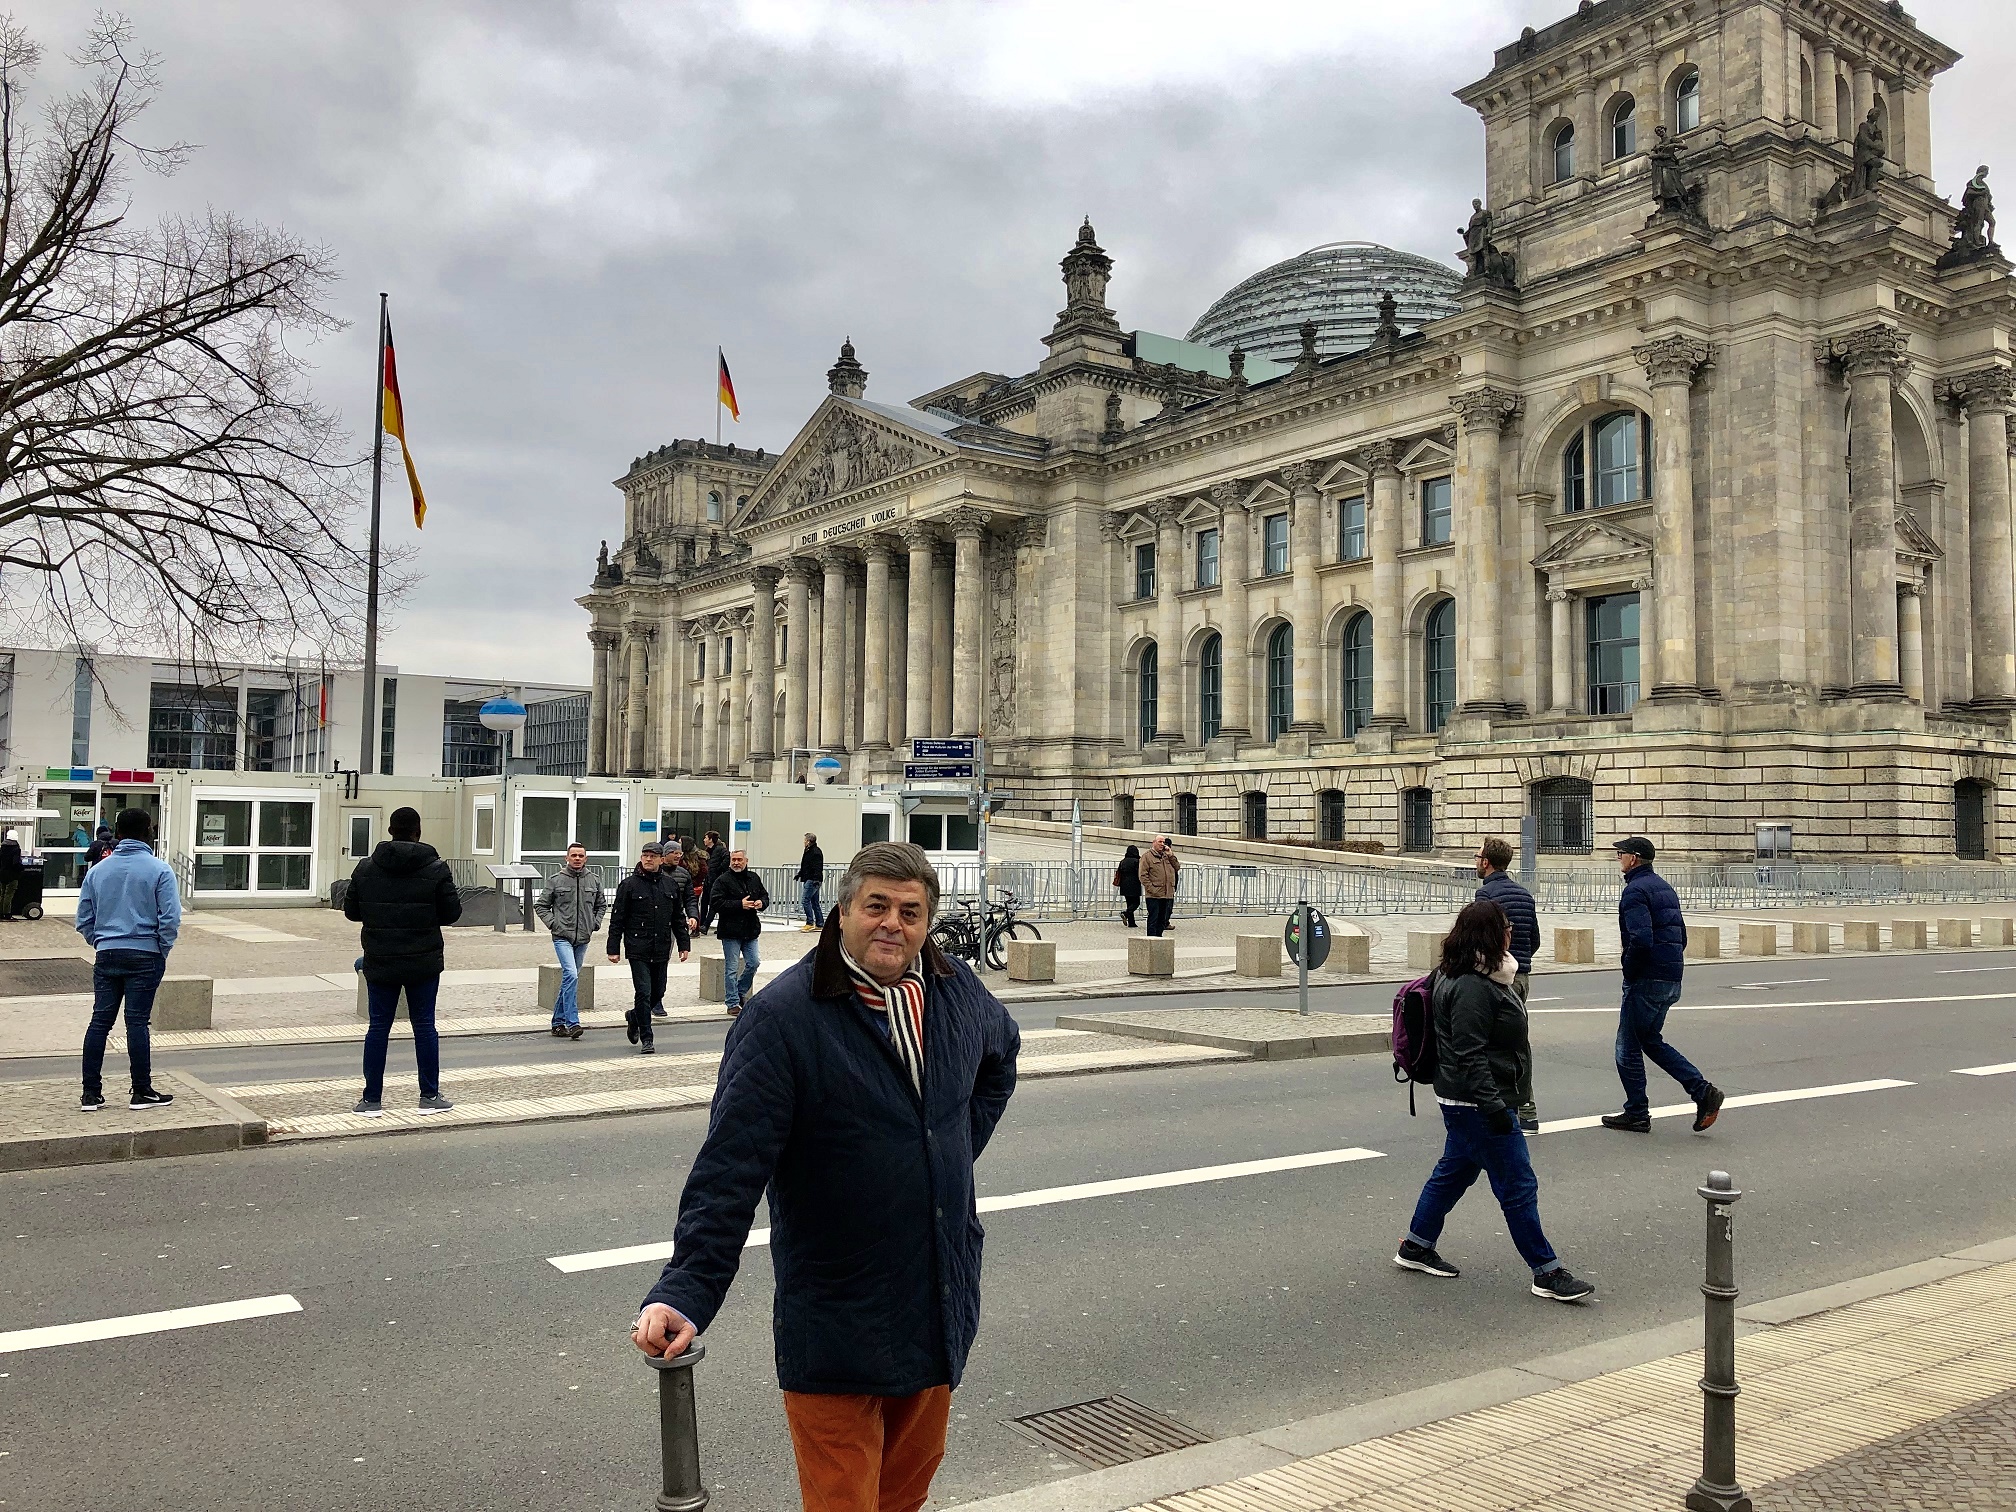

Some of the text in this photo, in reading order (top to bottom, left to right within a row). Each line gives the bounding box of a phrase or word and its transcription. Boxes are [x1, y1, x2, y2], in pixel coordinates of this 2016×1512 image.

[802, 508, 896, 545] DEM DEUTSCHEN VOLKE
